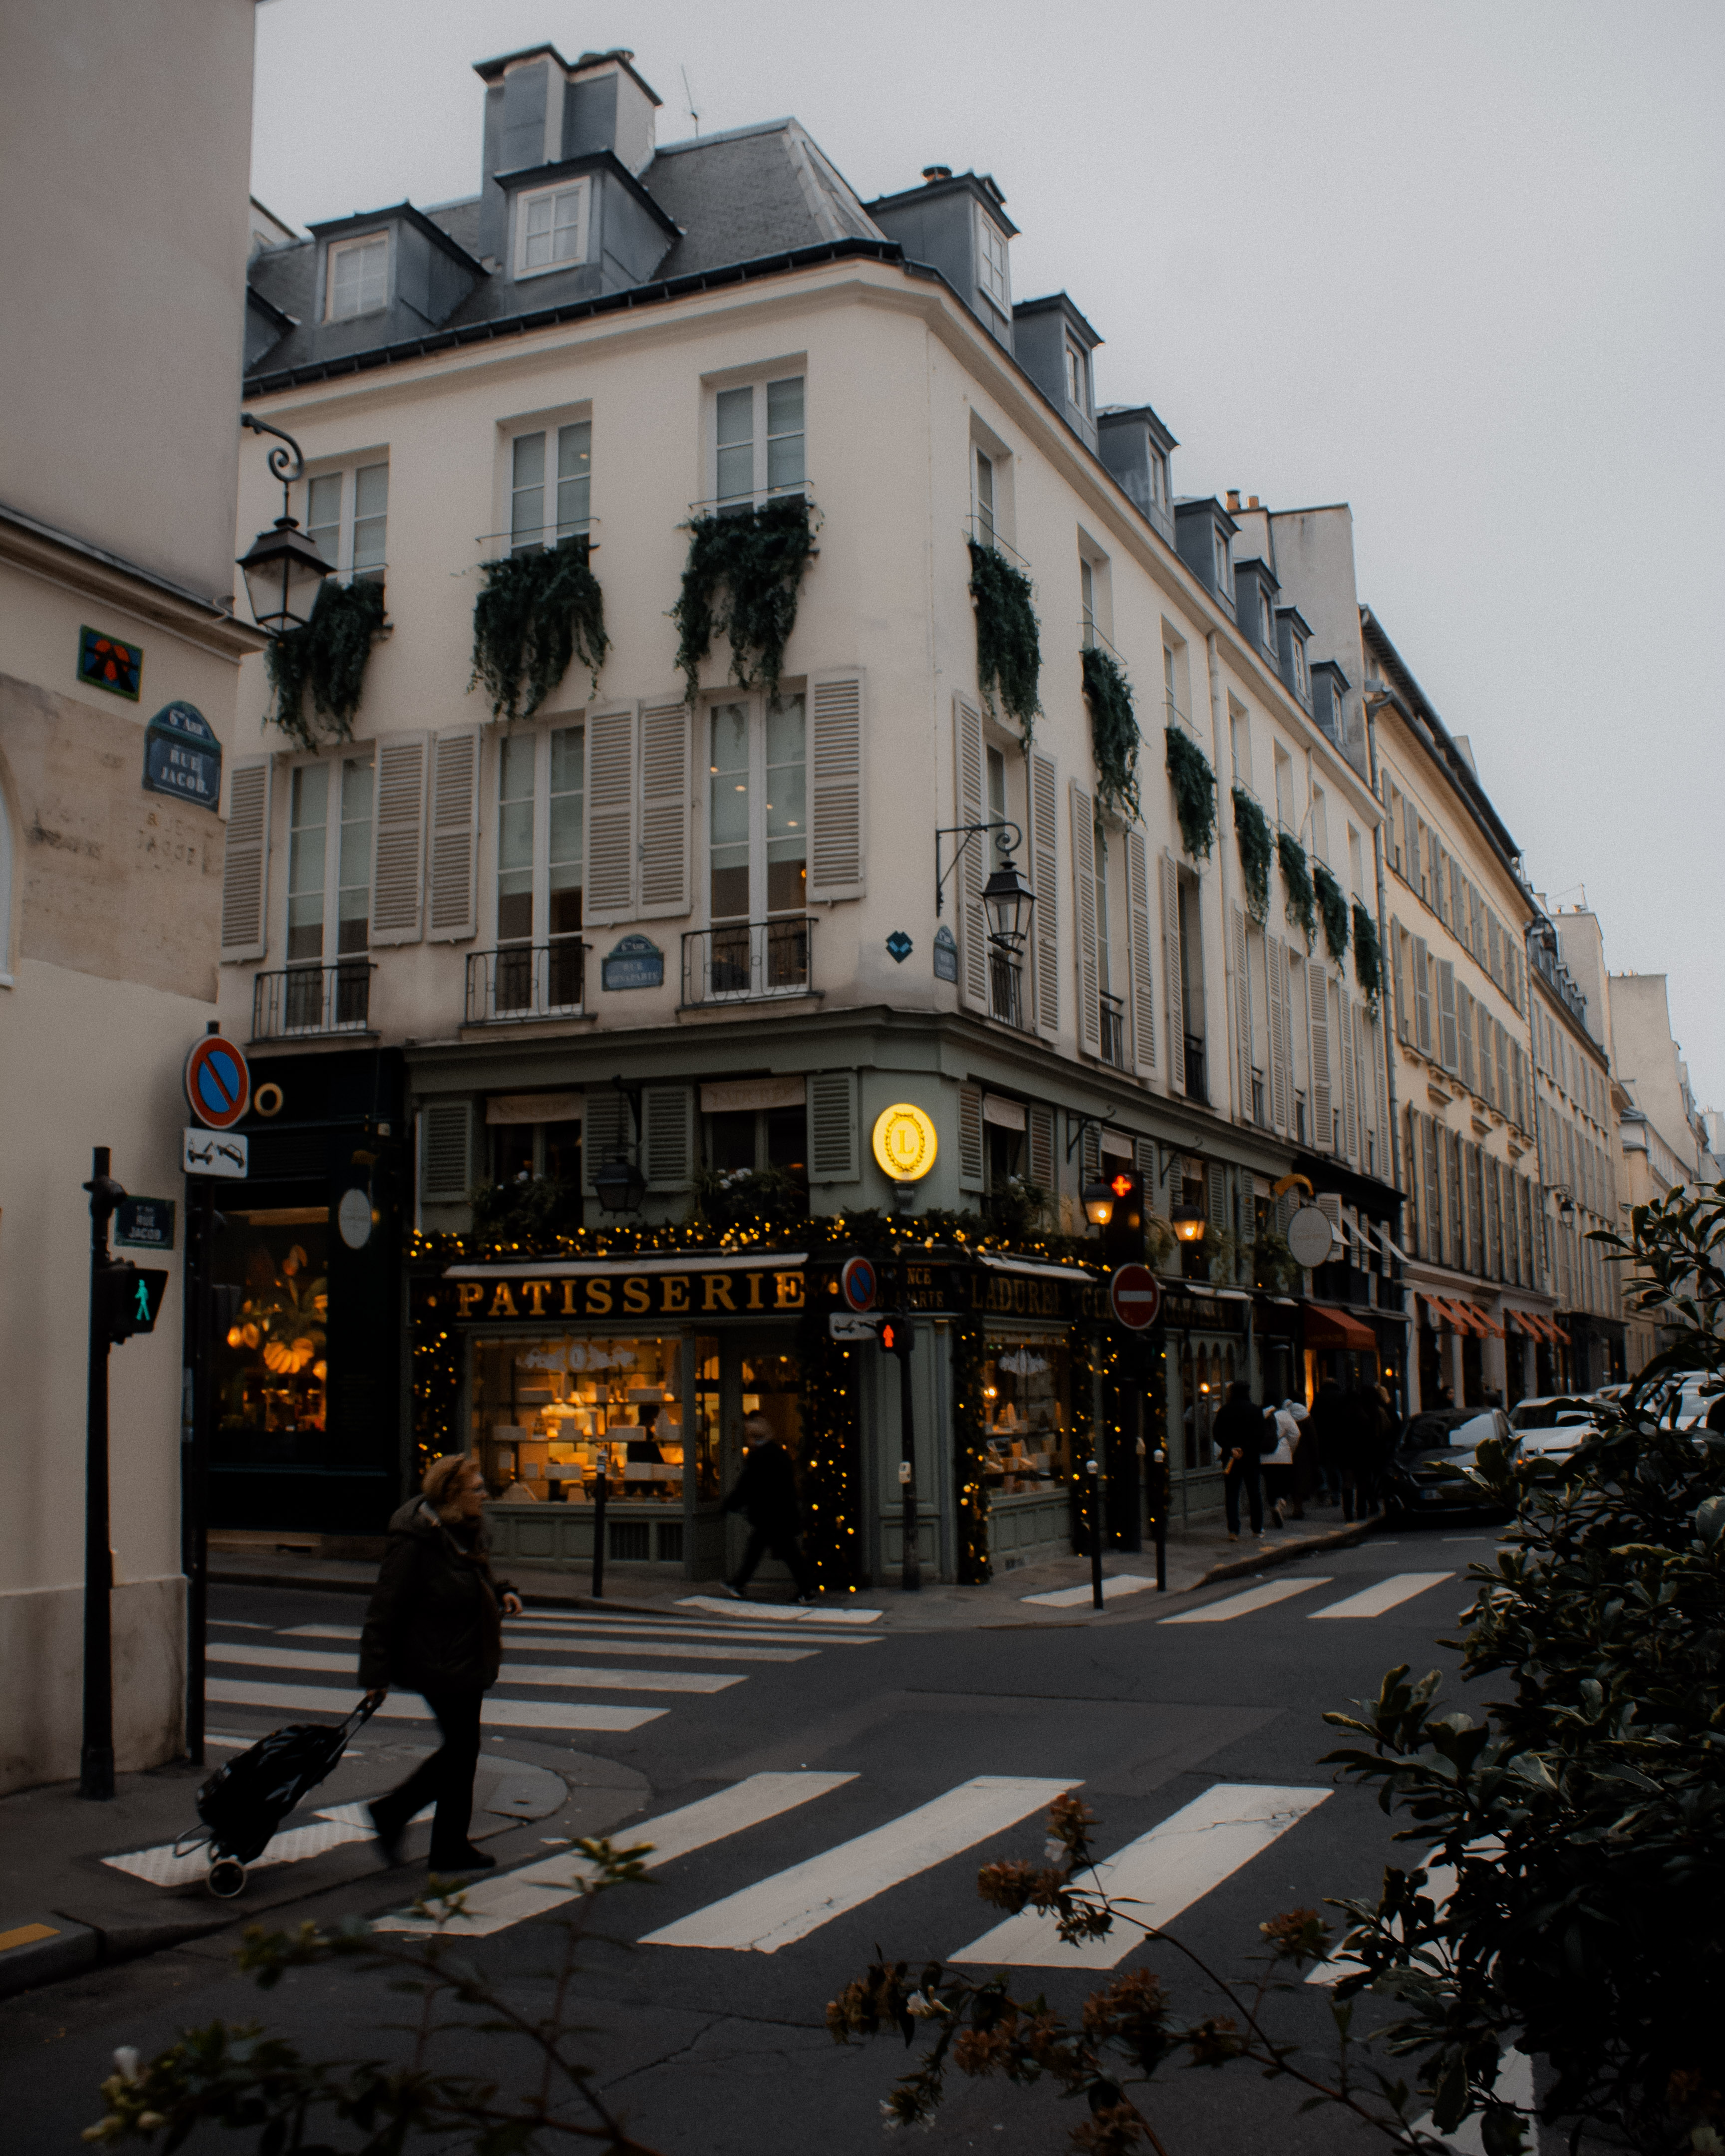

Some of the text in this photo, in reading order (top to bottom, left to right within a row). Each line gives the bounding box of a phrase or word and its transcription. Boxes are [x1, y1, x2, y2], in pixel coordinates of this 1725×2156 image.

[170, 748, 201, 772] RUE
[898, 1129, 915, 1154] L
[128, 1226, 162, 1241] JACOB
[456, 1271, 806, 1317] PATISSERIE
